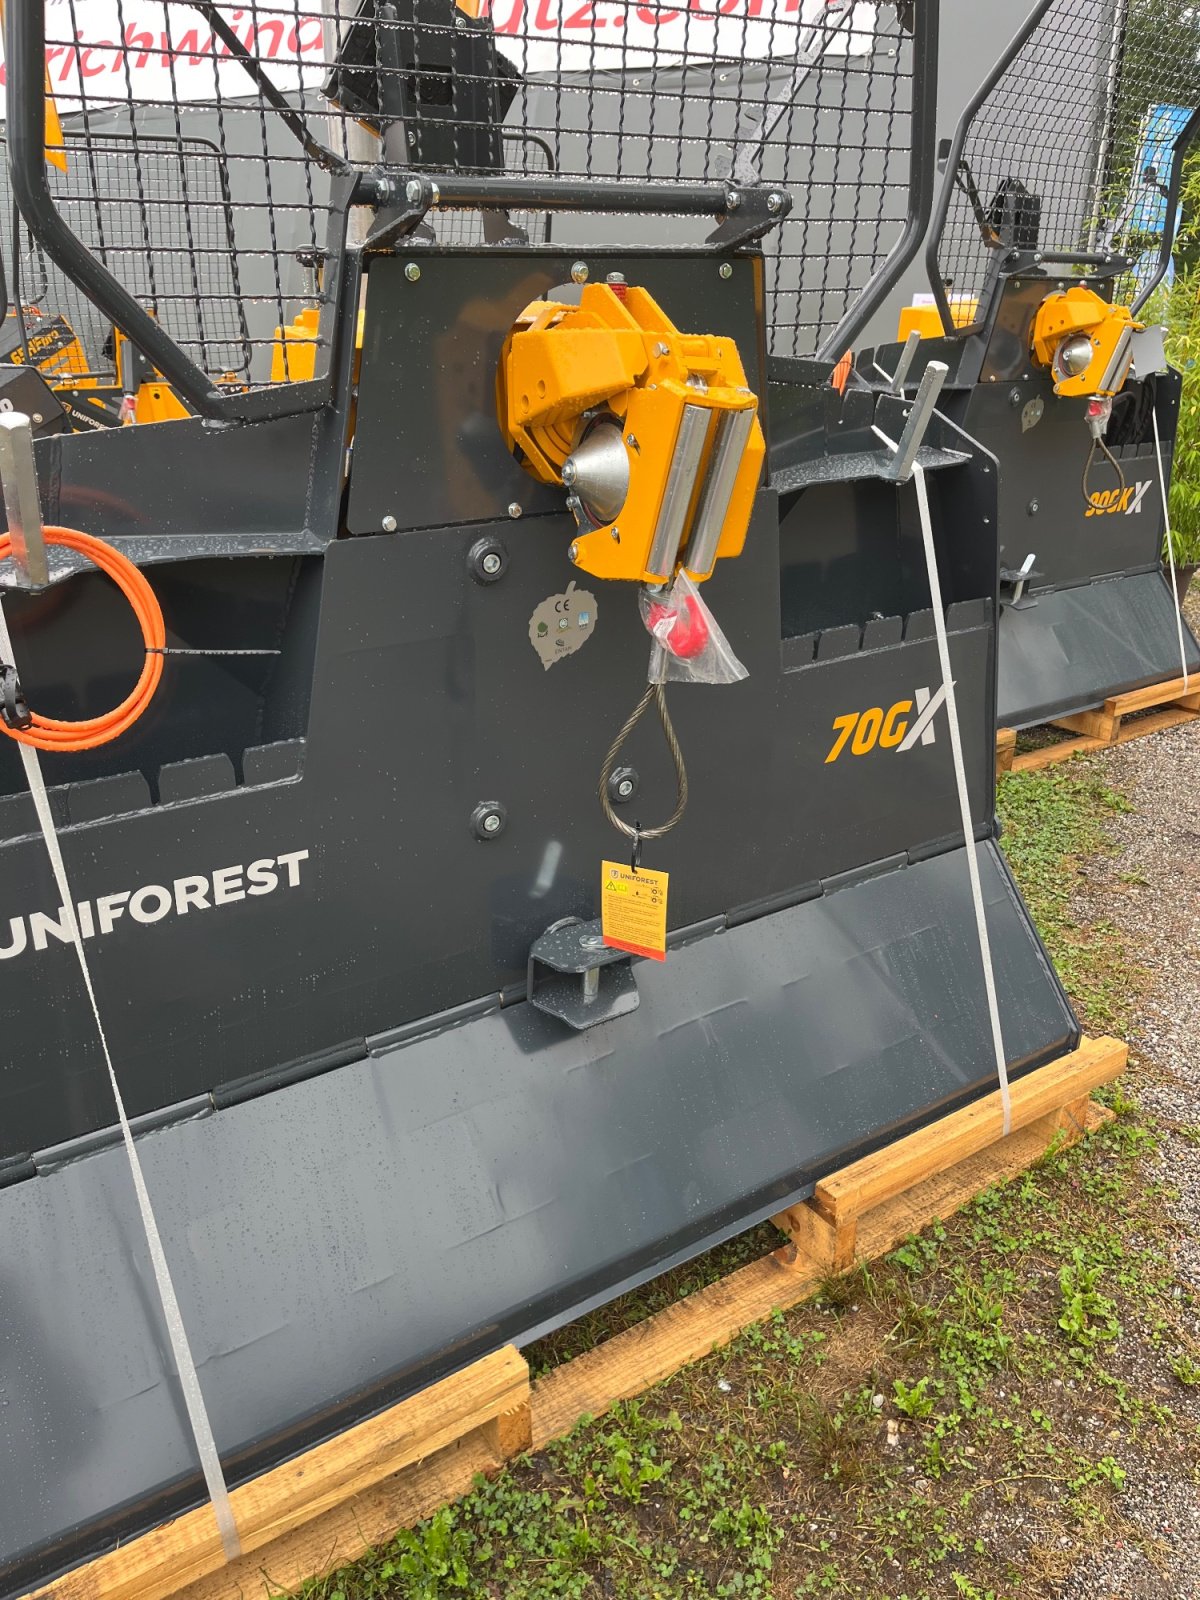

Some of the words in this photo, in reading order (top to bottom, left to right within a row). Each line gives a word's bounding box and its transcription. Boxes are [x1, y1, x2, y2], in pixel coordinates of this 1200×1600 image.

[824, 680, 958, 764] 70GX
[0, 849, 309, 960] UNIFOREST
[620, 873, 659, 885] UNIFOREST
